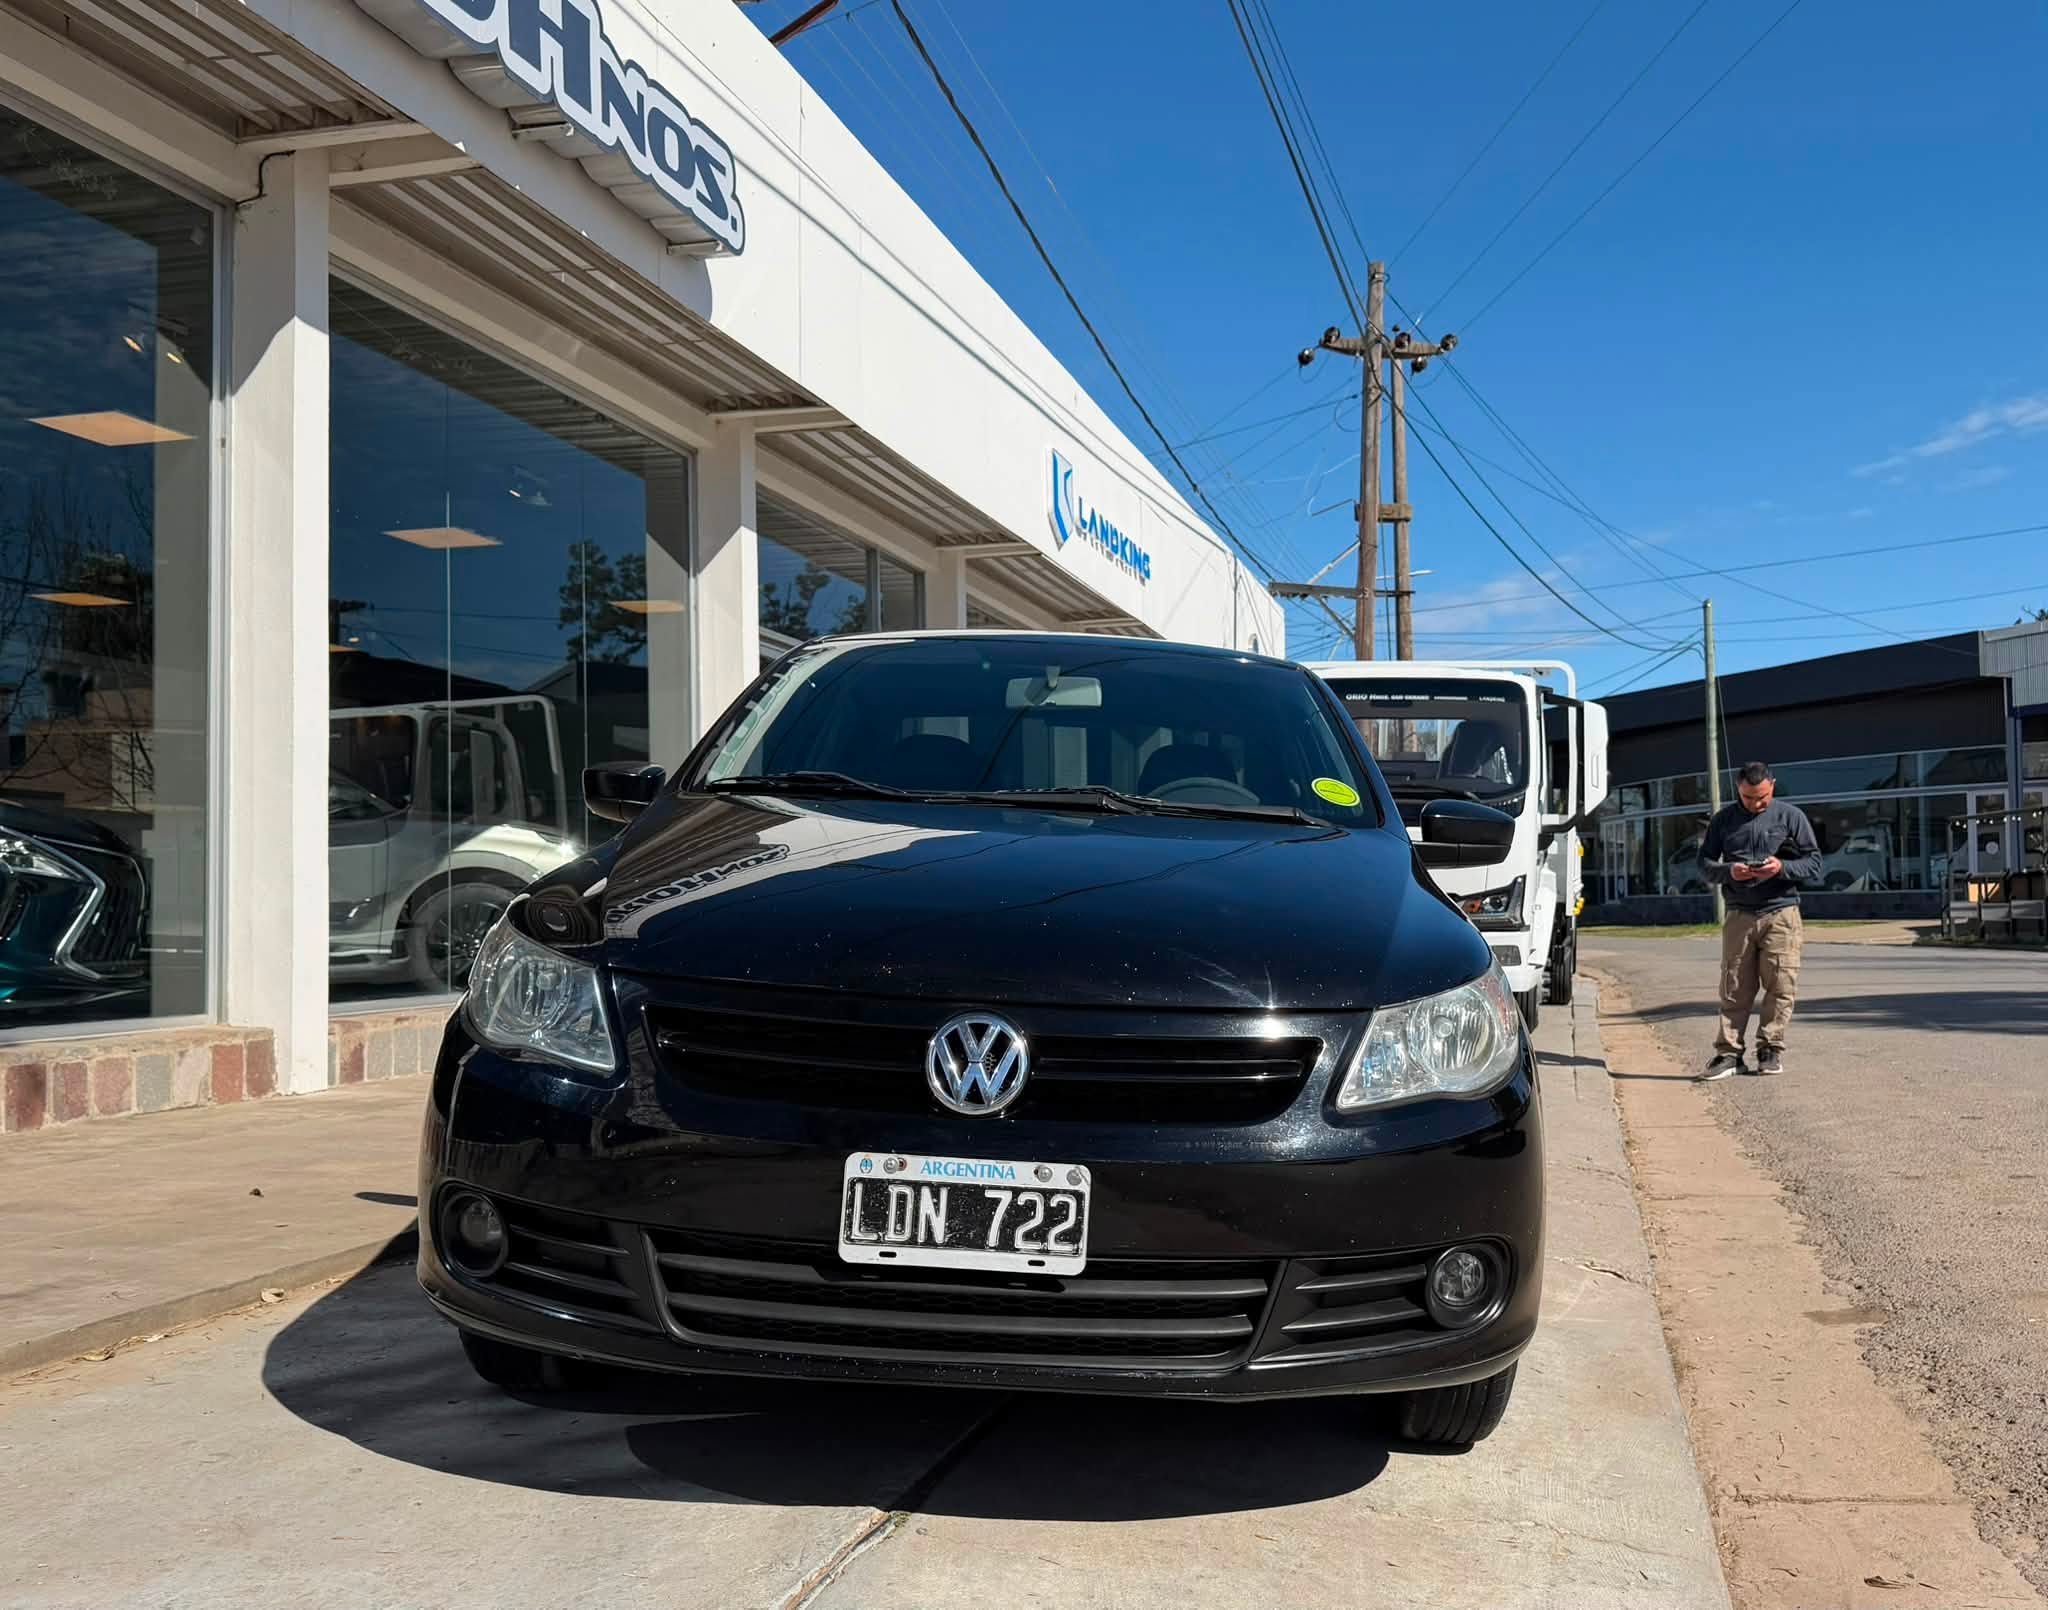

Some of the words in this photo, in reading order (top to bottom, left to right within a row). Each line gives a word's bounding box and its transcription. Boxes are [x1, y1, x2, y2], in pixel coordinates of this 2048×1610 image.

[1078, 495, 1151, 580] LANDKING
[930, 1016, 1027, 1112] VW
[919, 1159, 1017, 1181] ARGENTINA
[850, 1182, 949, 1245] LDN
[984, 1189, 1079, 1252] 722
